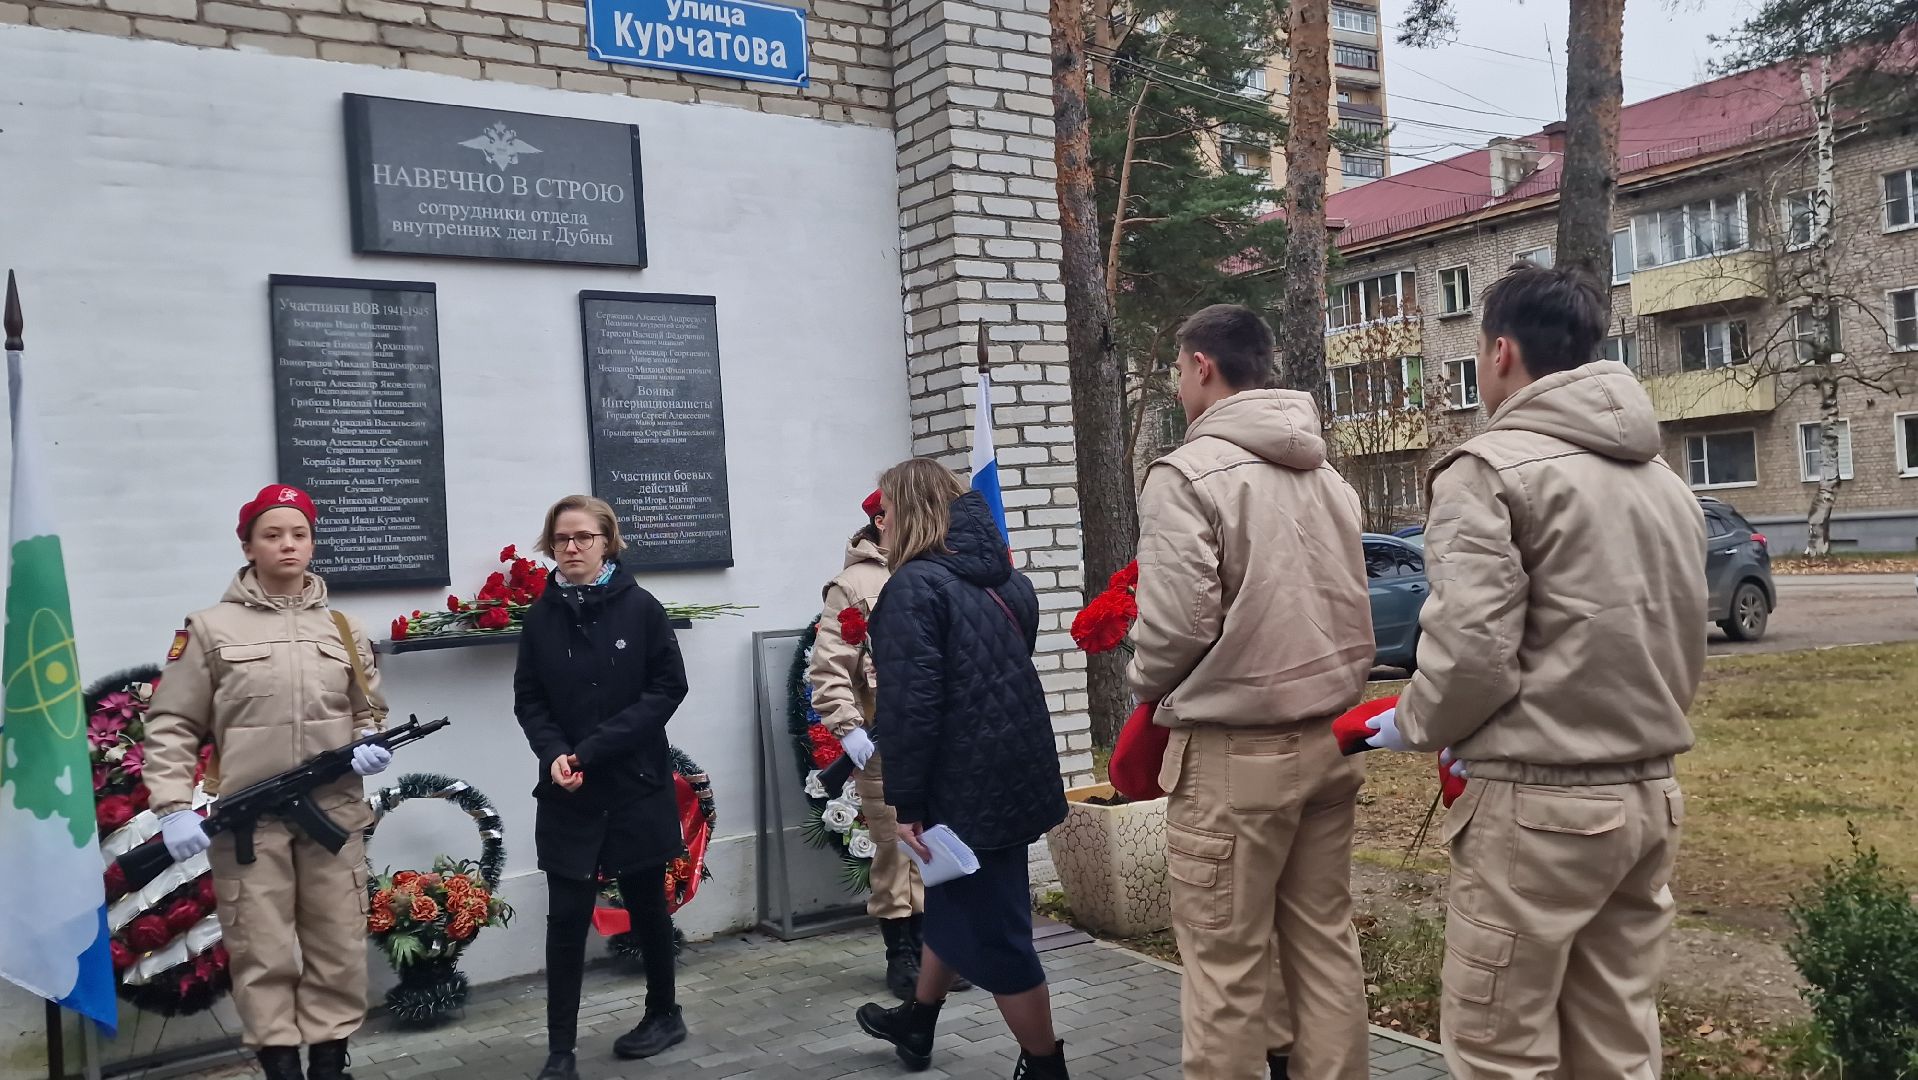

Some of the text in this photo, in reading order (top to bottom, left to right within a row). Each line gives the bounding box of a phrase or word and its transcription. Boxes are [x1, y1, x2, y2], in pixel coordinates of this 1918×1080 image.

[667, 0, 746, 27] улица
[614, 11, 787, 69] Курчатова
[372, 163, 624, 203] НАВЕЧНО В СТРОЮ
[418, 202, 589, 226] сотрудники отдела
[392, 220, 614, 246] внутренних дел г.Дубны
[280, 298, 429, 316] Участники ВОВ 1941-1945
[628, 348, 667, 358] Александр
[279, 358, 332, 369] Виноградов
[372, 360, 433, 371] Владимирович
[635, 365, 664, 374] Михаил
[329, 379, 378, 389] Александр
[380, 380, 427, 389] Яковлевич
[637, 385, 674, 396] Воины
[332, 399, 372, 408] Николай
[374, 399, 426, 409] Николаевич
[602, 398, 712, 410] Интернационалисты
[641, 411, 667, 421] Сергей
[668, 411, 710, 420] Алексеевич
[332, 418, 372, 428] Аркадий
[374, 419, 426, 427] Васильевич
[645, 429, 671, 439] Сергей
[672, 429, 715, 437] Николаевич
[329, 438, 378, 448] Александр
[380, 437, 428, 446] Семёнович
[348, 457, 382, 468] Виктор
[384, 457, 422, 467] Кузьмич
[611, 469, 712, 482] Участники боевых
[377, 477, 419, 486] Петровна
[638, 482, 688, 494] действий
[338, 496, 377, 505] Николай
[380, 496, 429, 506] Фёдорович
[645, 497, 667, 505] Игорь
[668, 496, 712, 504] Викторович
[315, 515, 415, 525] Мягков Иван Кузьмич
[632, 513, 663, 523] Валерий
[665, 512, 724, 521] Константинович
[359, 535, 382, 544] Иван
[384, 534, 427, 544] Павлович
[644, 531, 679, 541] Александр
[680, 530, 727, 538] Александрович
[334, 555, 371, 564] Михаил
[373, 554, 435, 566] Никифорович
